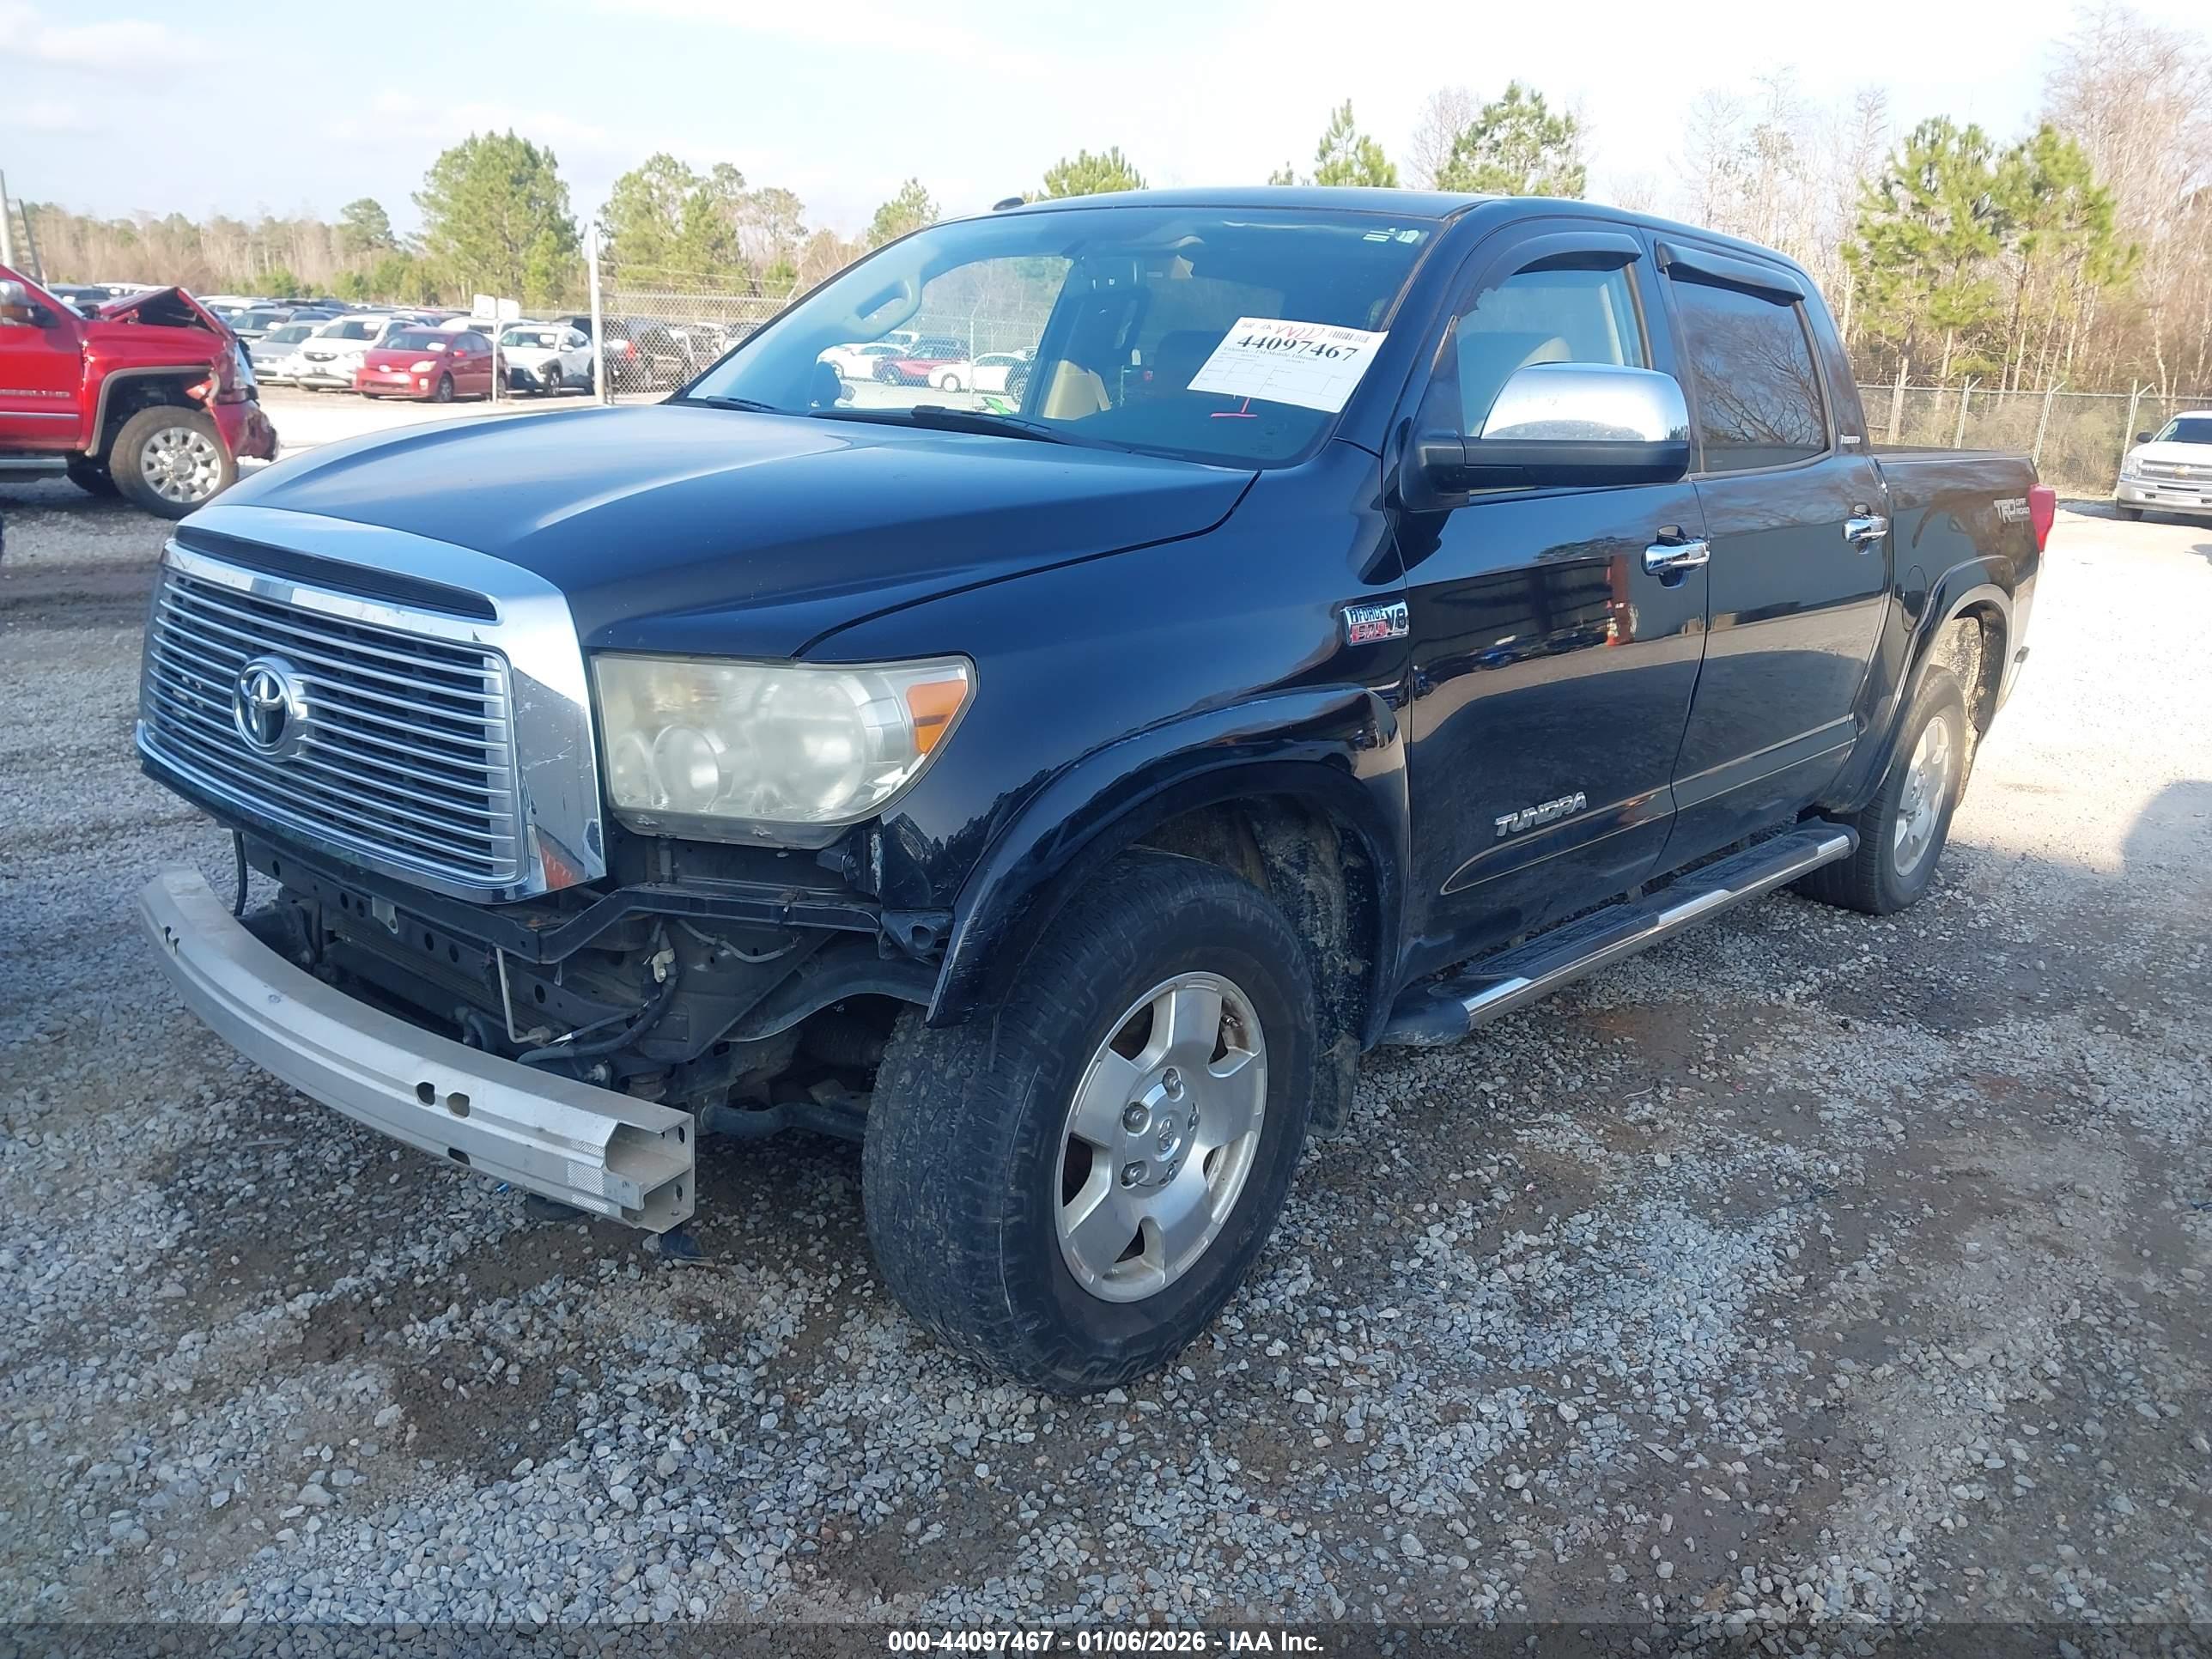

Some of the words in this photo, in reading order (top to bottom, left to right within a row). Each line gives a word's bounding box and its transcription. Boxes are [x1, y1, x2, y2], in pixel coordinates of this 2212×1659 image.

[1237, 335, 1360, 362] 44097467
[1385, 608, 1407, 631] V8
[1495, 791, 1587, 837] TUNDRA
